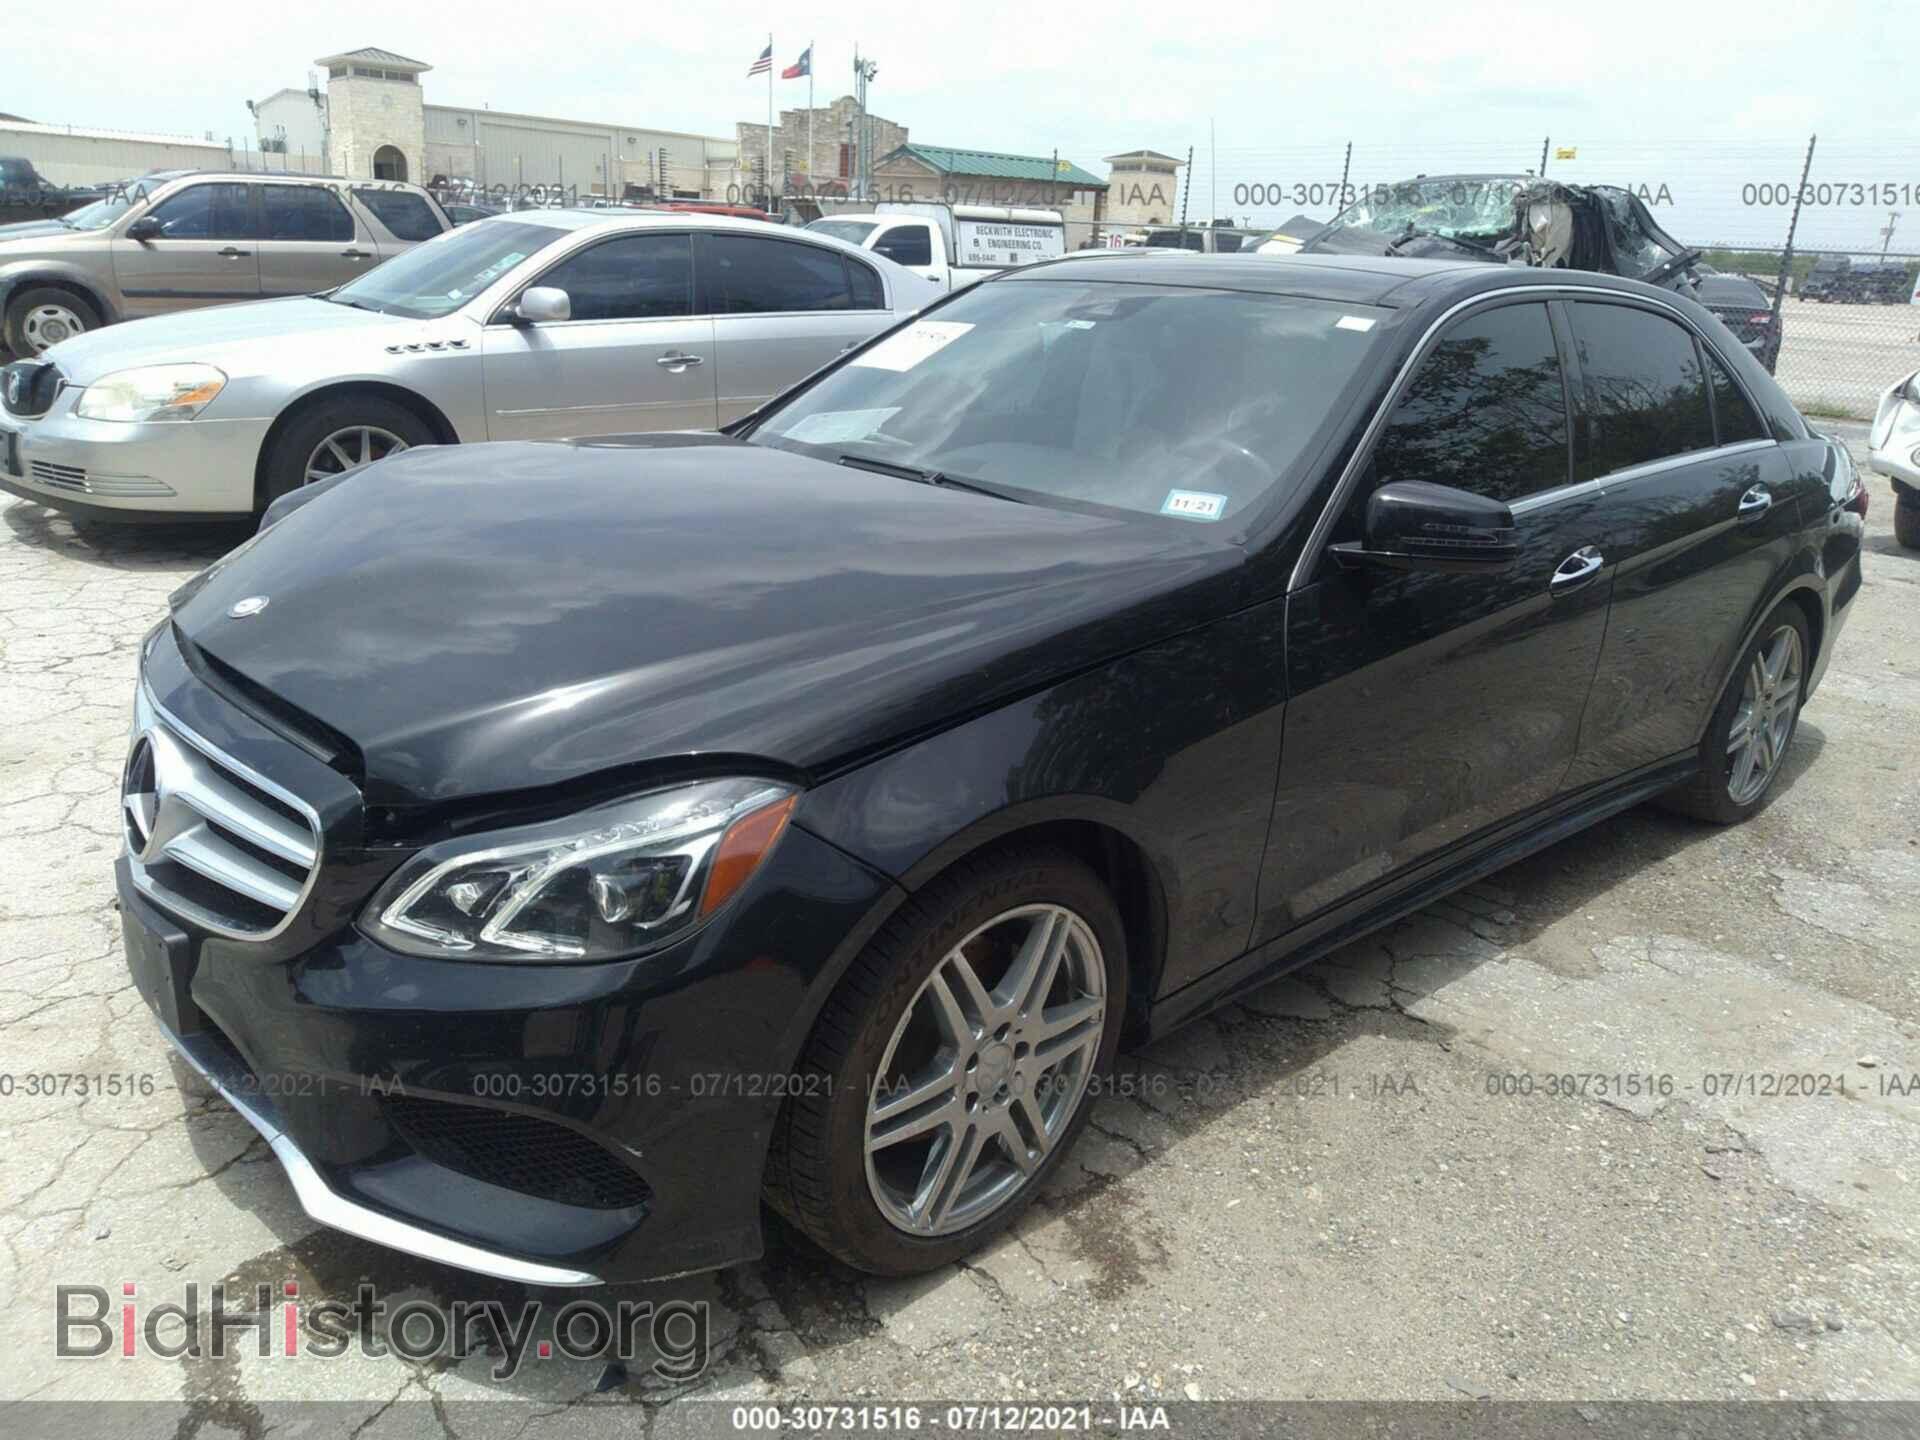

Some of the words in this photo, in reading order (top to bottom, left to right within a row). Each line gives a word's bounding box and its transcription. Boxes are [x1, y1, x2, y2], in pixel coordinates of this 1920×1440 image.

[976, 225, 1013, 237] BECKWITH
[1015, 227, 1053, 239] ELECTRONIC
[988, 239, 1031, 250] ENGINEERING
